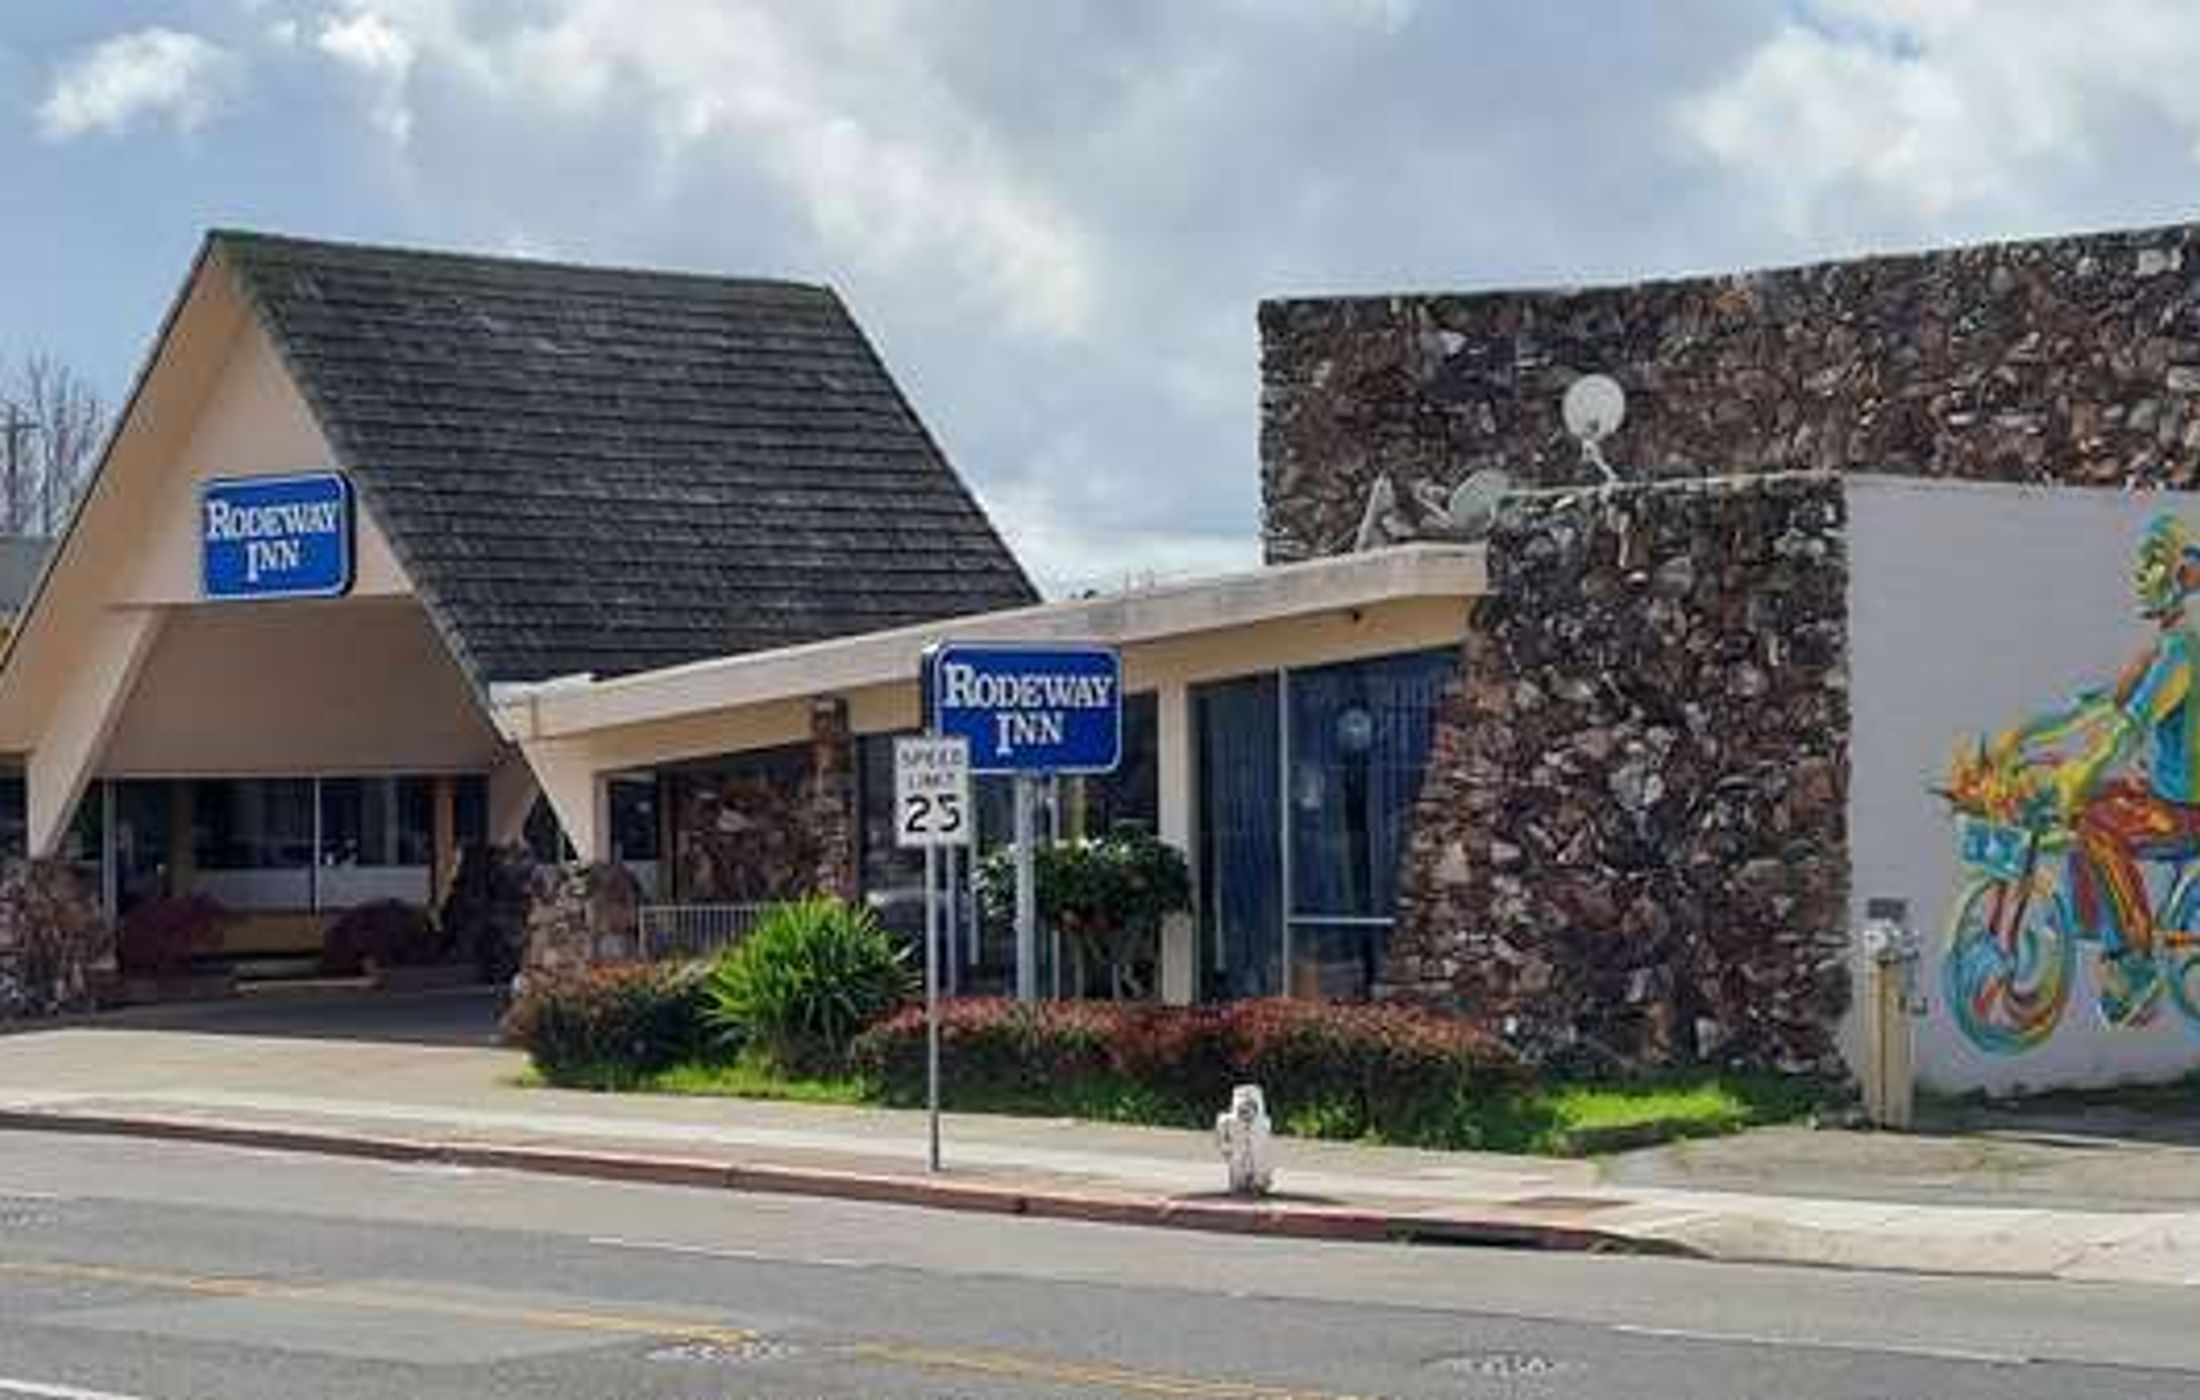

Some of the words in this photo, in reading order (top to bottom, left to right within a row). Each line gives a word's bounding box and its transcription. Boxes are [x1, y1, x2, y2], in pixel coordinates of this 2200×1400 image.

[206, 500, 337, 541] RODEWAY
[247, 539, 300, 583] INN
[942, 663, 1113, 708] RODEWAY
[996, 711, 1064, 756] INN
[900, 747, 963, 768] SPEED
[907, 771, 956, 790] LIMIT
[905, 794, 960, 832] 25
